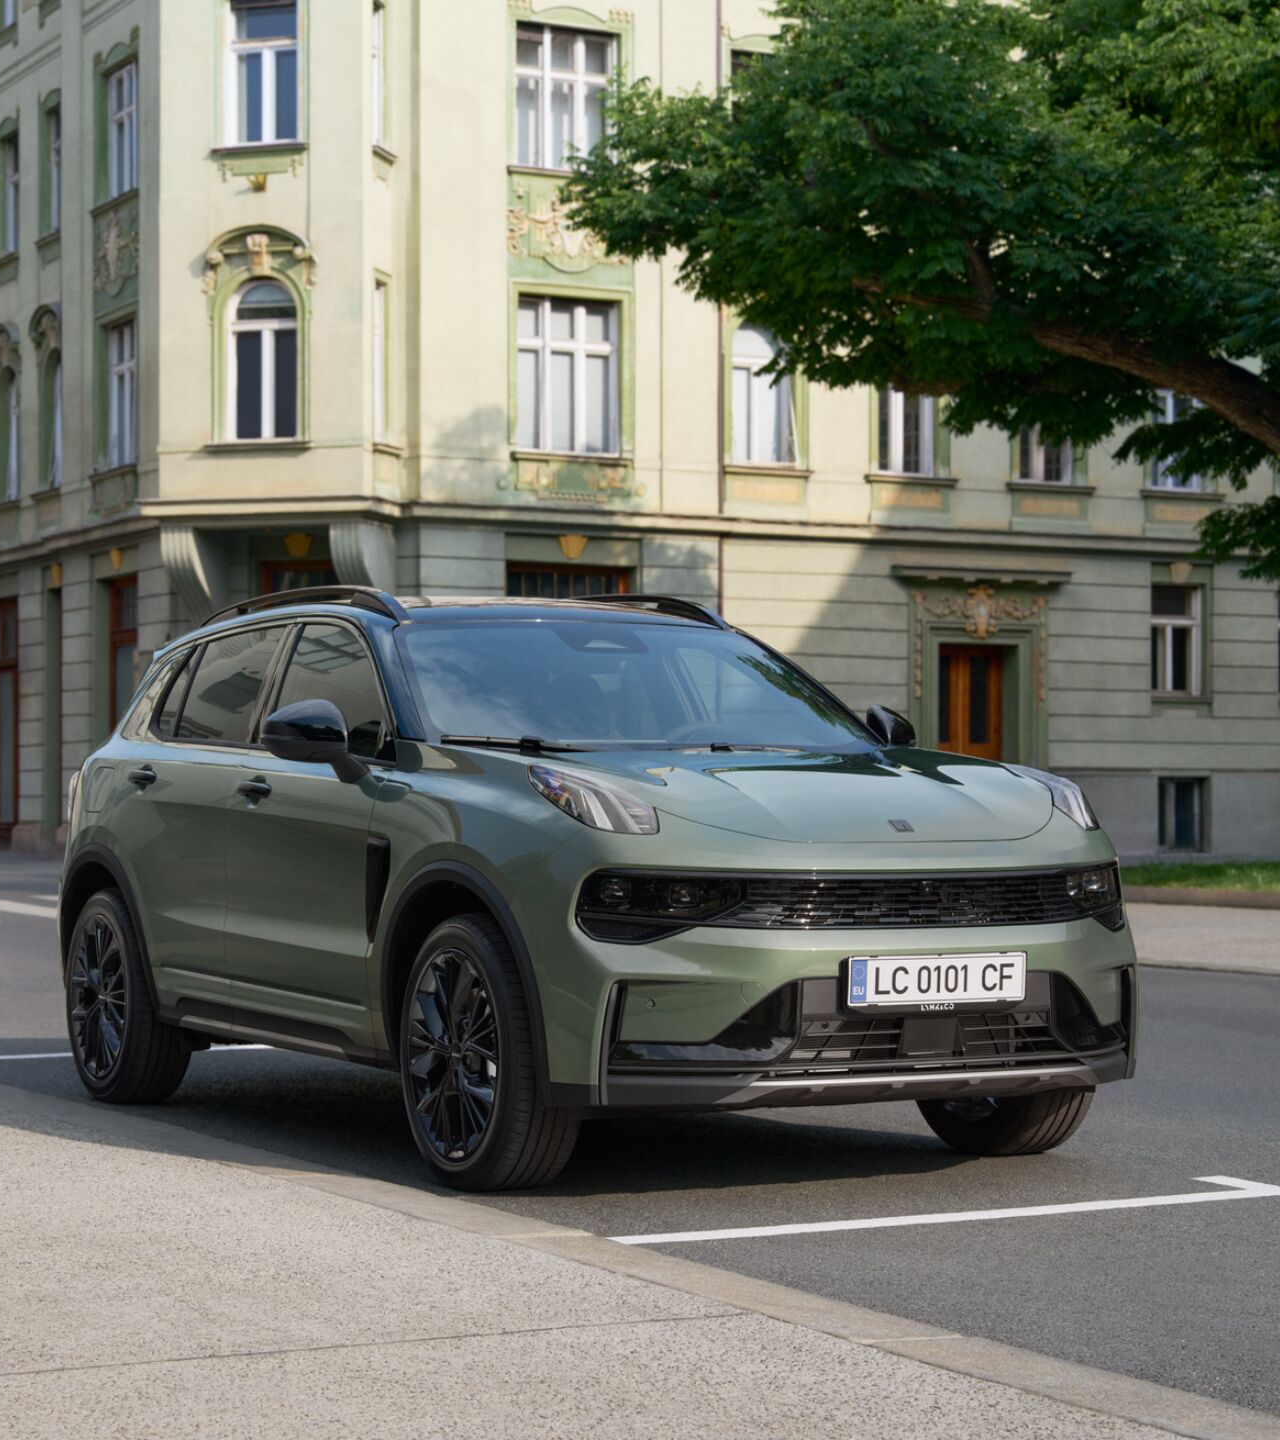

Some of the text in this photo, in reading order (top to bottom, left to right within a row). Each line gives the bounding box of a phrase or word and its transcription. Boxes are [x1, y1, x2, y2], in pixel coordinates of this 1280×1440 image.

[874, 963, 1015, 995] LC 0101 CF
[853, 986, 864, 995] EU
